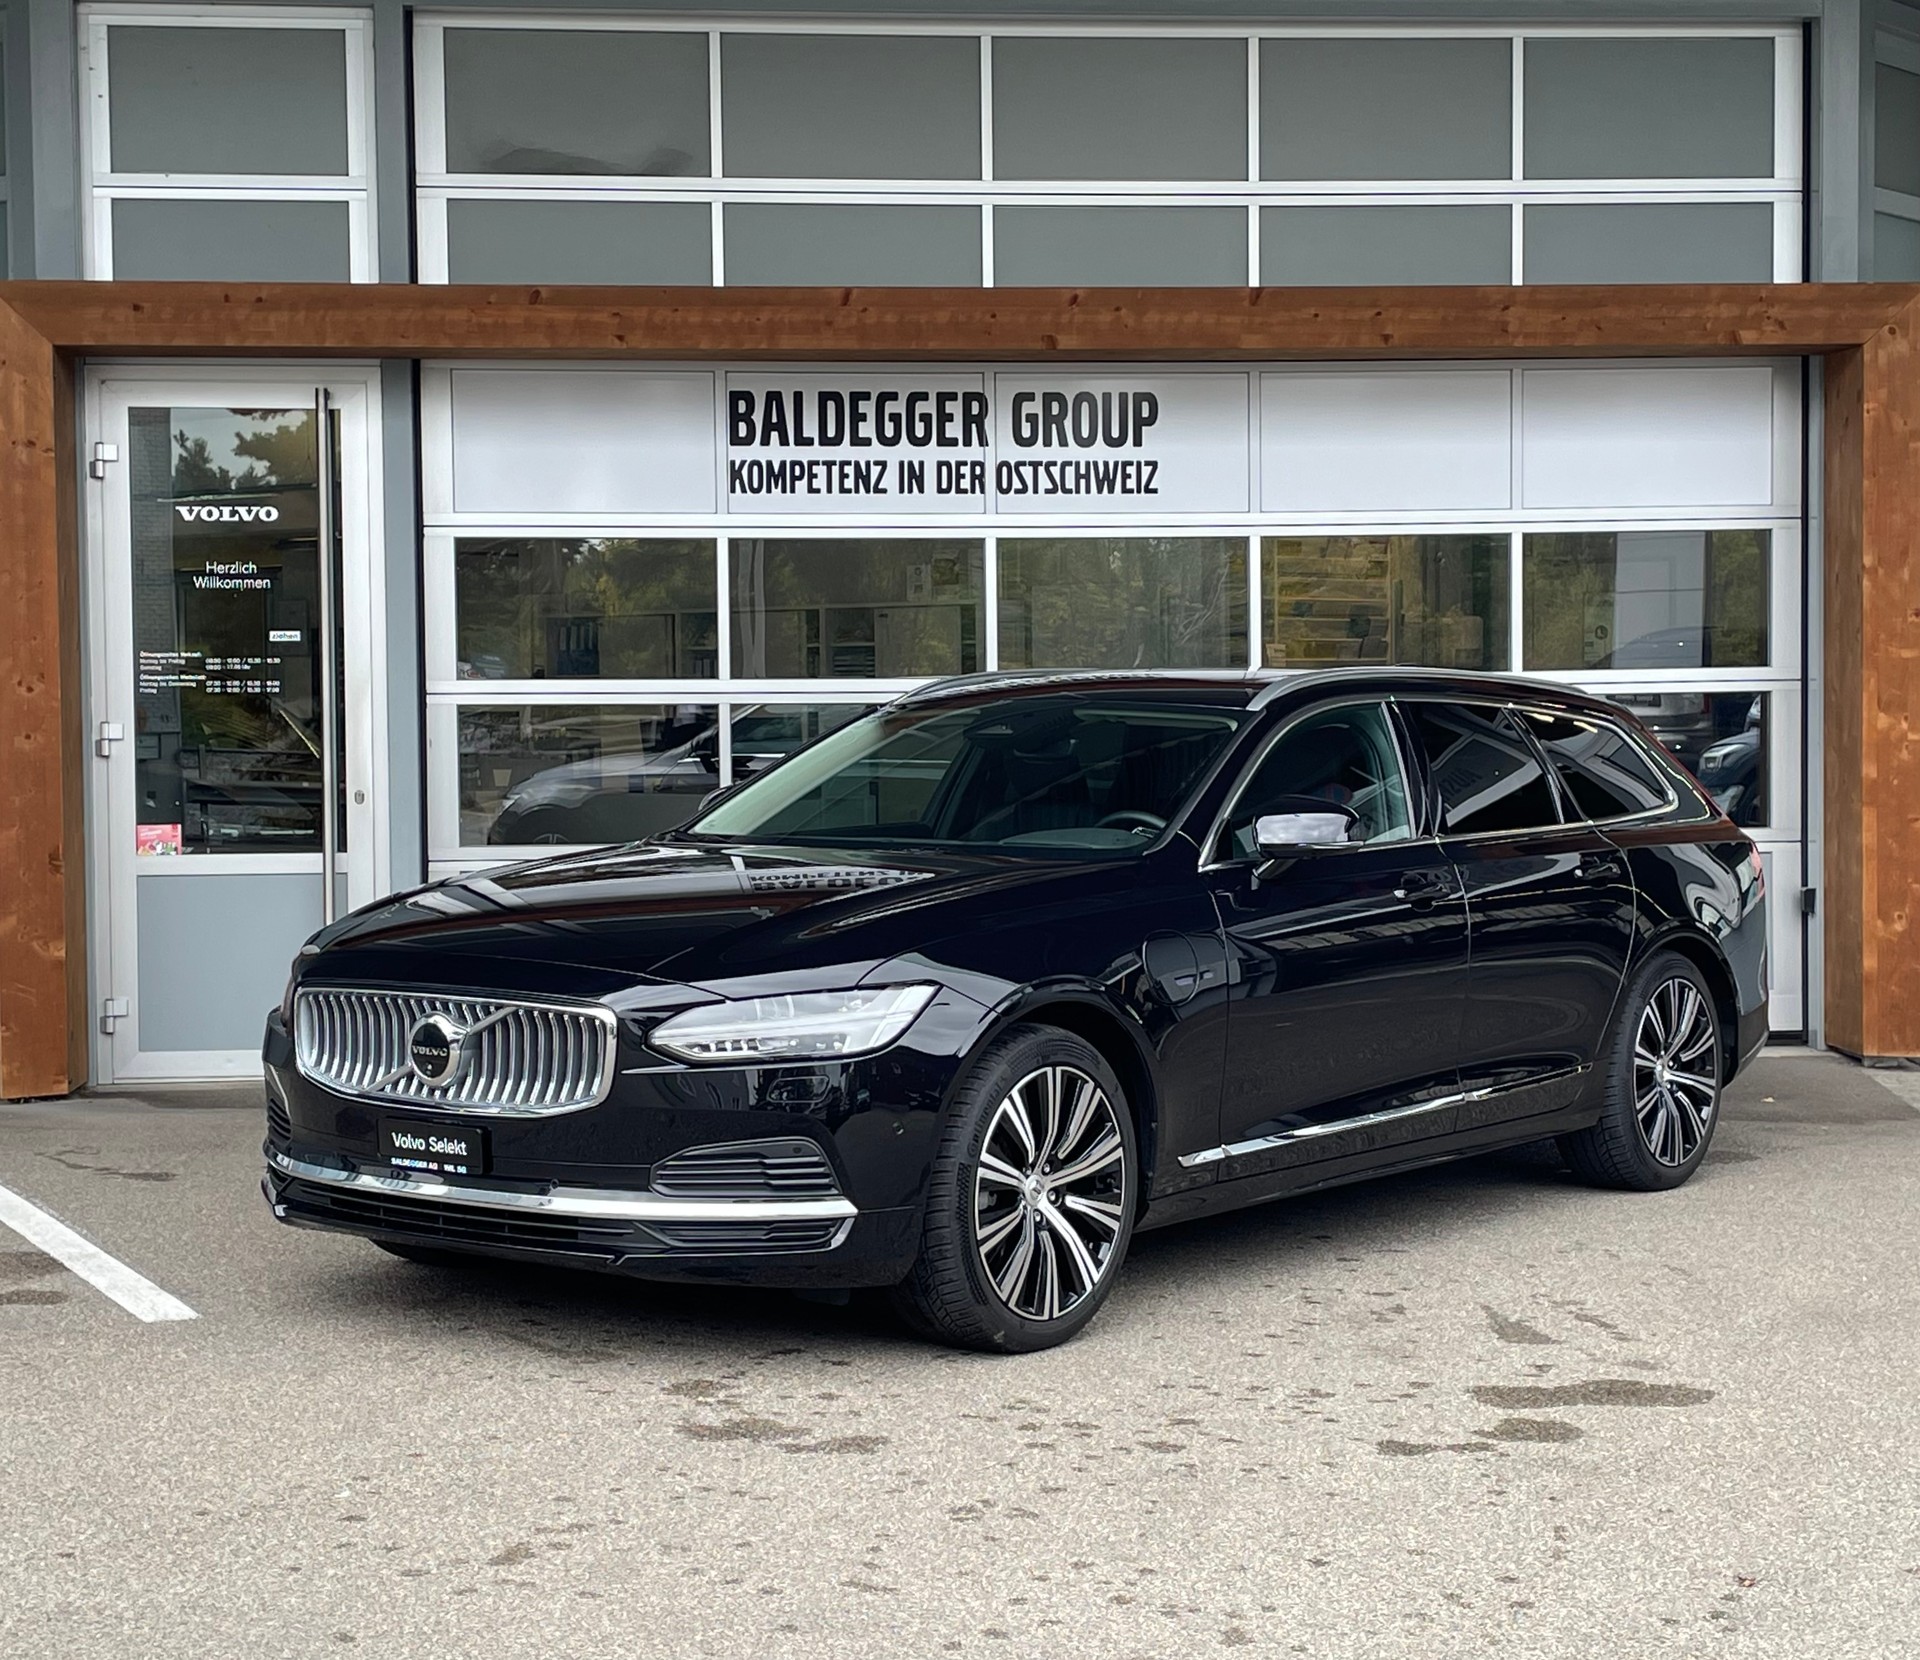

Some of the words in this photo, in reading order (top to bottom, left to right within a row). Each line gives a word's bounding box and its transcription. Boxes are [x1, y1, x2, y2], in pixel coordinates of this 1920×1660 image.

[729, 391, 989, 447] BALDEGGER
[1011, 391, 1159, 448] GROUP
[729, 460, 888, 495] KOMPETENZ
[898, 460, 925, 495] IN
[936, 460, 985, 495] DER
[996, 460, 1159, 495] OSTSCHWEIZ
[175, 505, 279, 522] VOLVO
[205, 561, 257, 574] Herzlich
[193, 576, 271, 589] Willkommen
[411, 1045, 448, 1057] VOLVO
[391, 1131, 426, 1151] Volvo
[428, 1136, 467, 1156] Selekt
